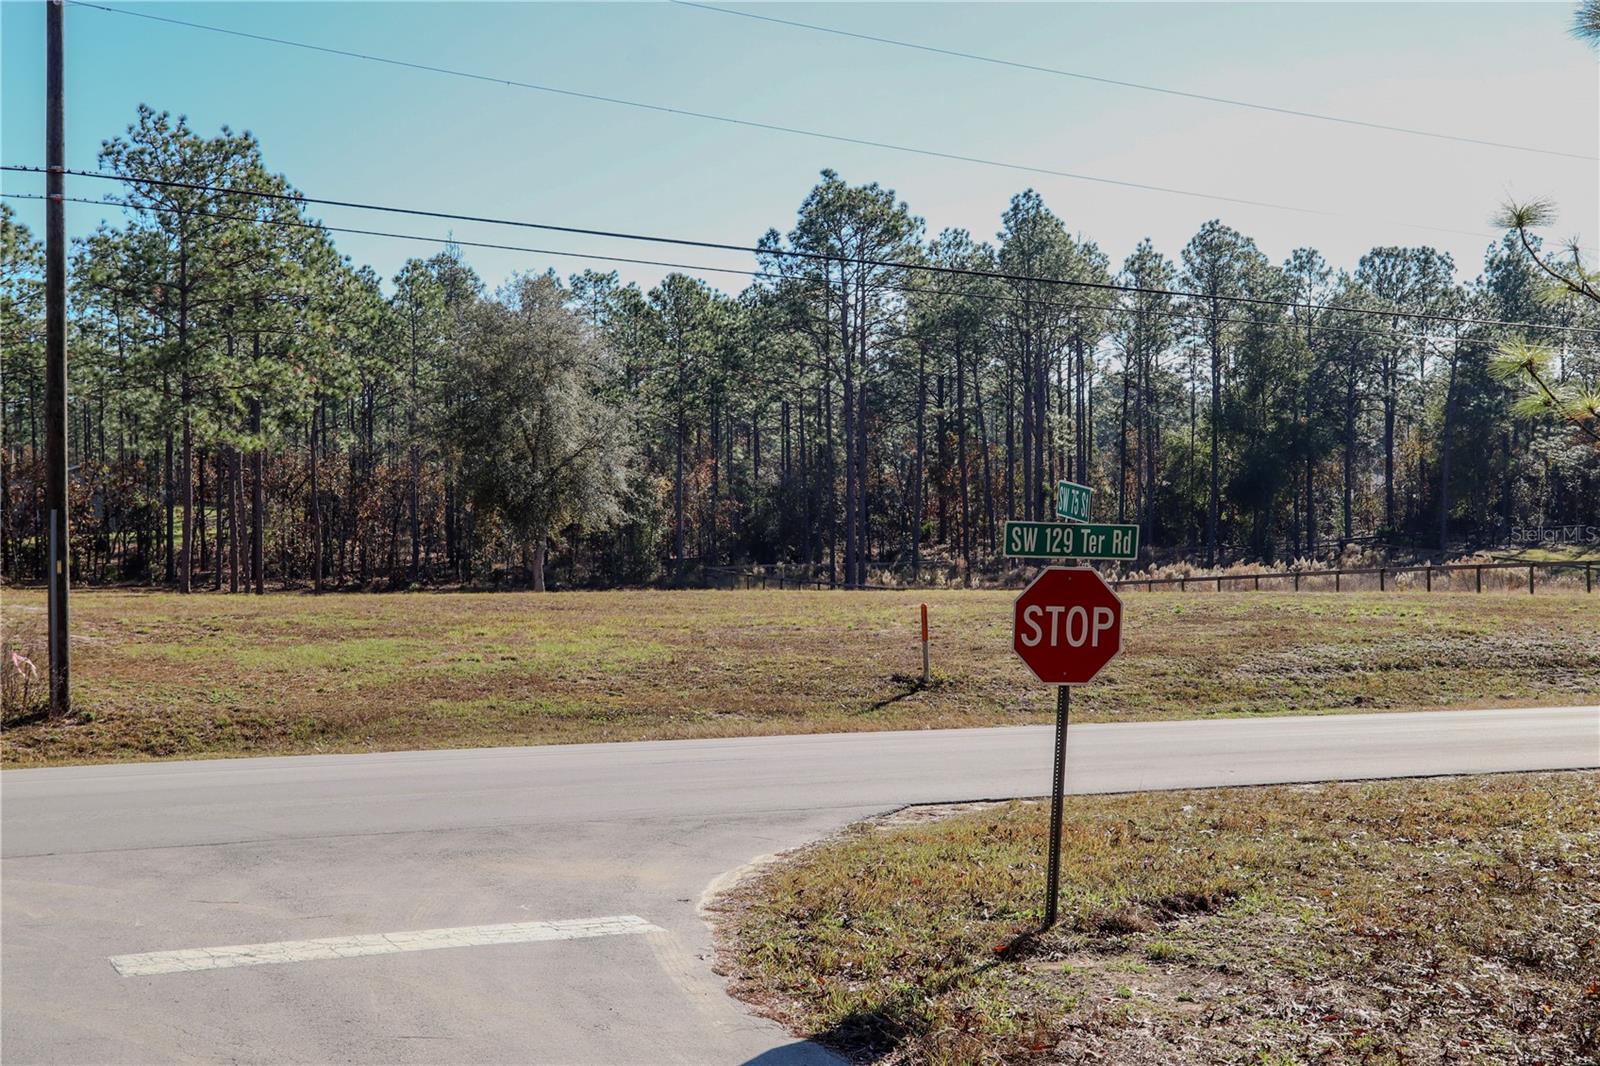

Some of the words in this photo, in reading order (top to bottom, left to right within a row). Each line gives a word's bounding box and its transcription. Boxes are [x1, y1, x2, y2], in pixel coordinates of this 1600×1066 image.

[1059, 486, 1070, 512] SW
[1070, 489, 1079, 515] 75
[1081, 491, 1088, 517] St
[1011, 526, 1038, 553] SW
[1045, 527, 1073, 554] 129
[1081, 528, 1105, 554] Ter
[1112, 529, 1132, 555] Rd
[1021, 604, 1115, 648] STOP
